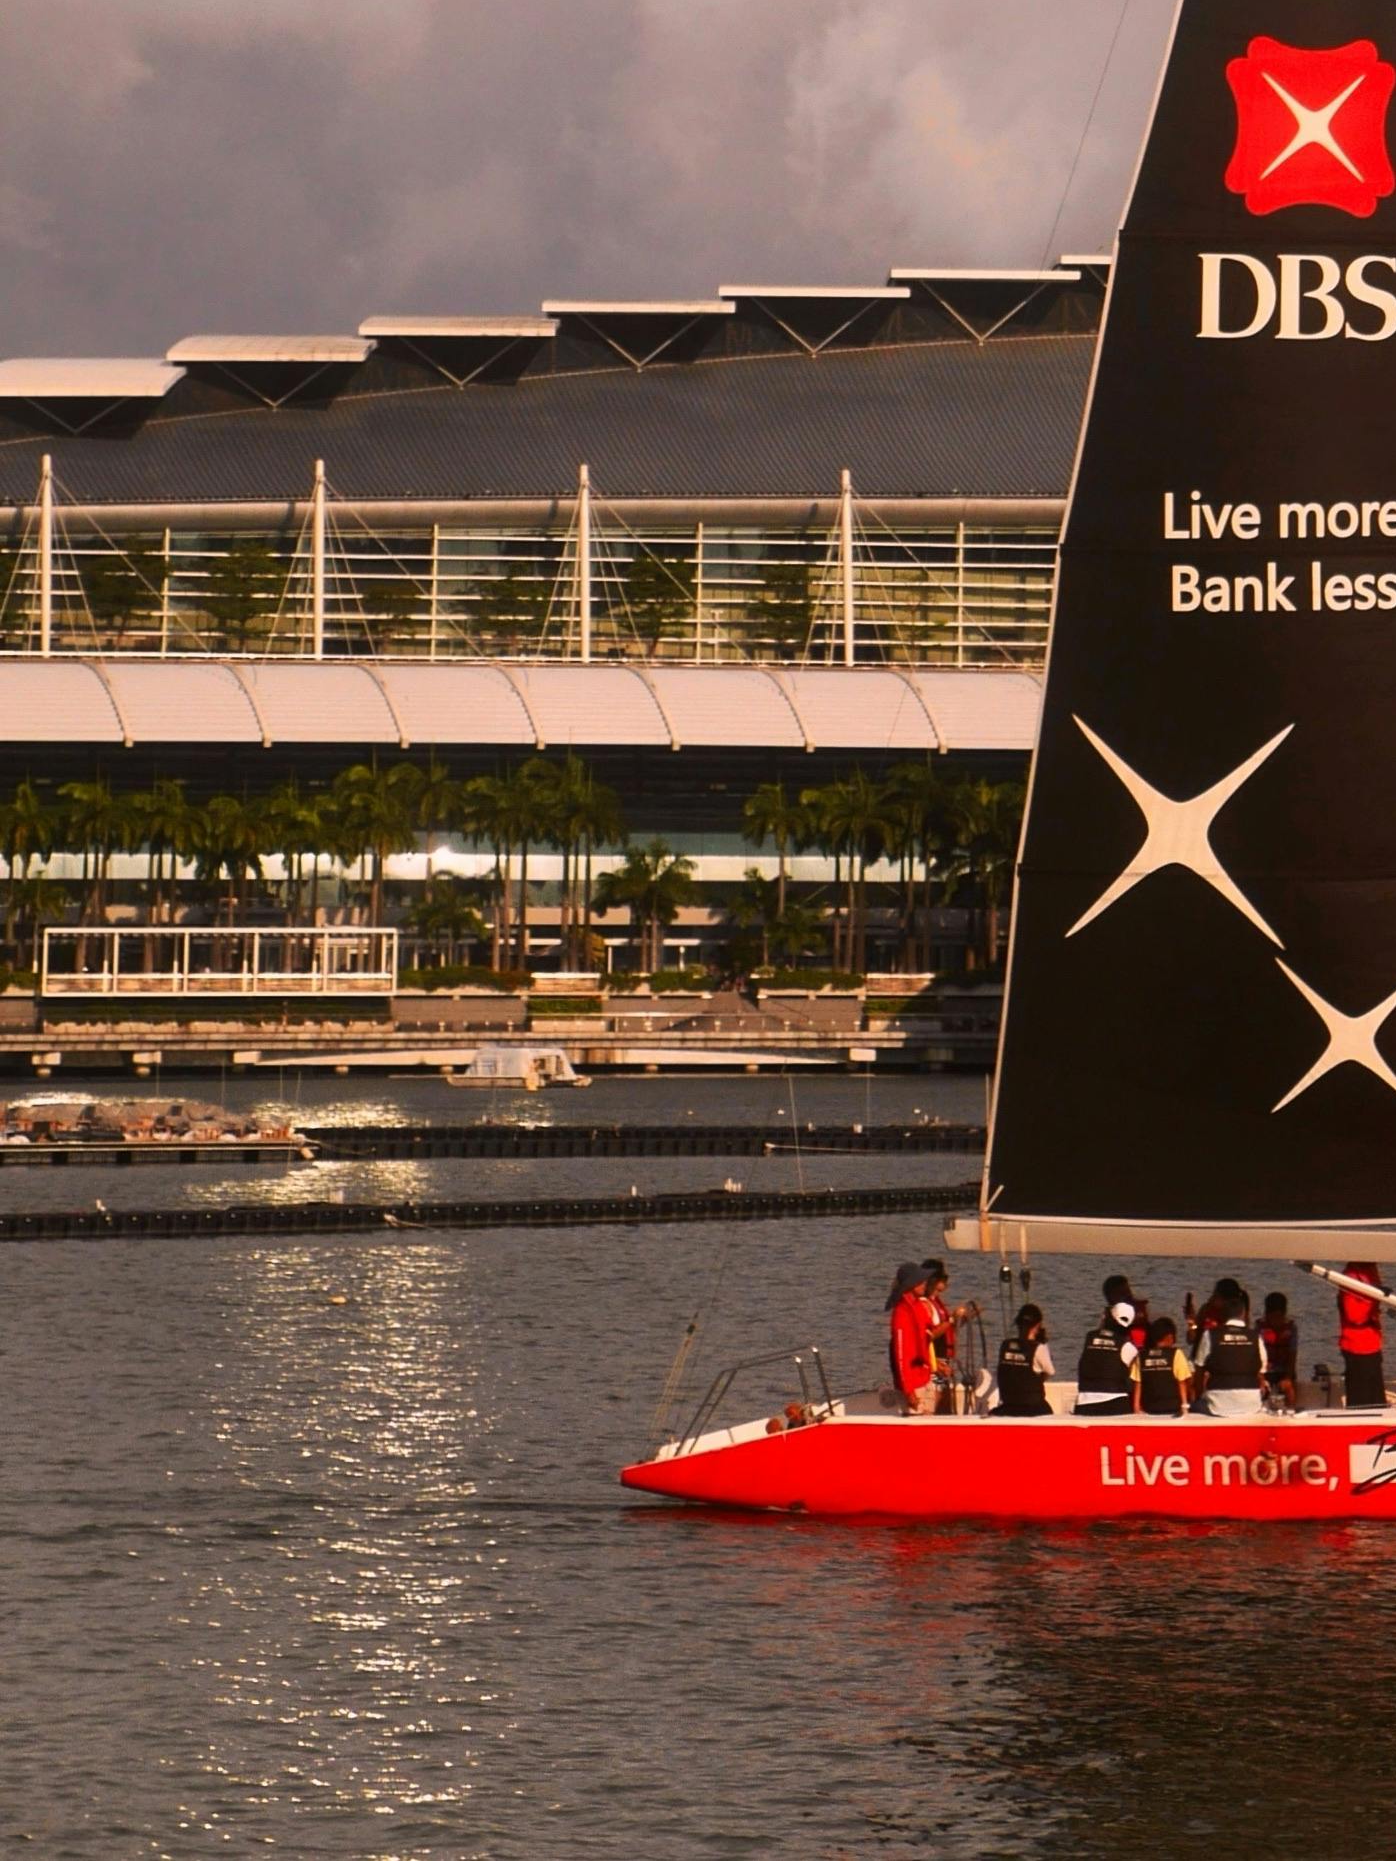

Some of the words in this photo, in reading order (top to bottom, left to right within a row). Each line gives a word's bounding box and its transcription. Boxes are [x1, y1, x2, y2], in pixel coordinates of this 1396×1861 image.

[1163, 490, 1261, 539] Live
[1171, 562, 1296, 612] Bank
[1100, 1444, 1190, 1487] Live
[1204, 1453, 1338, 1491] more,
